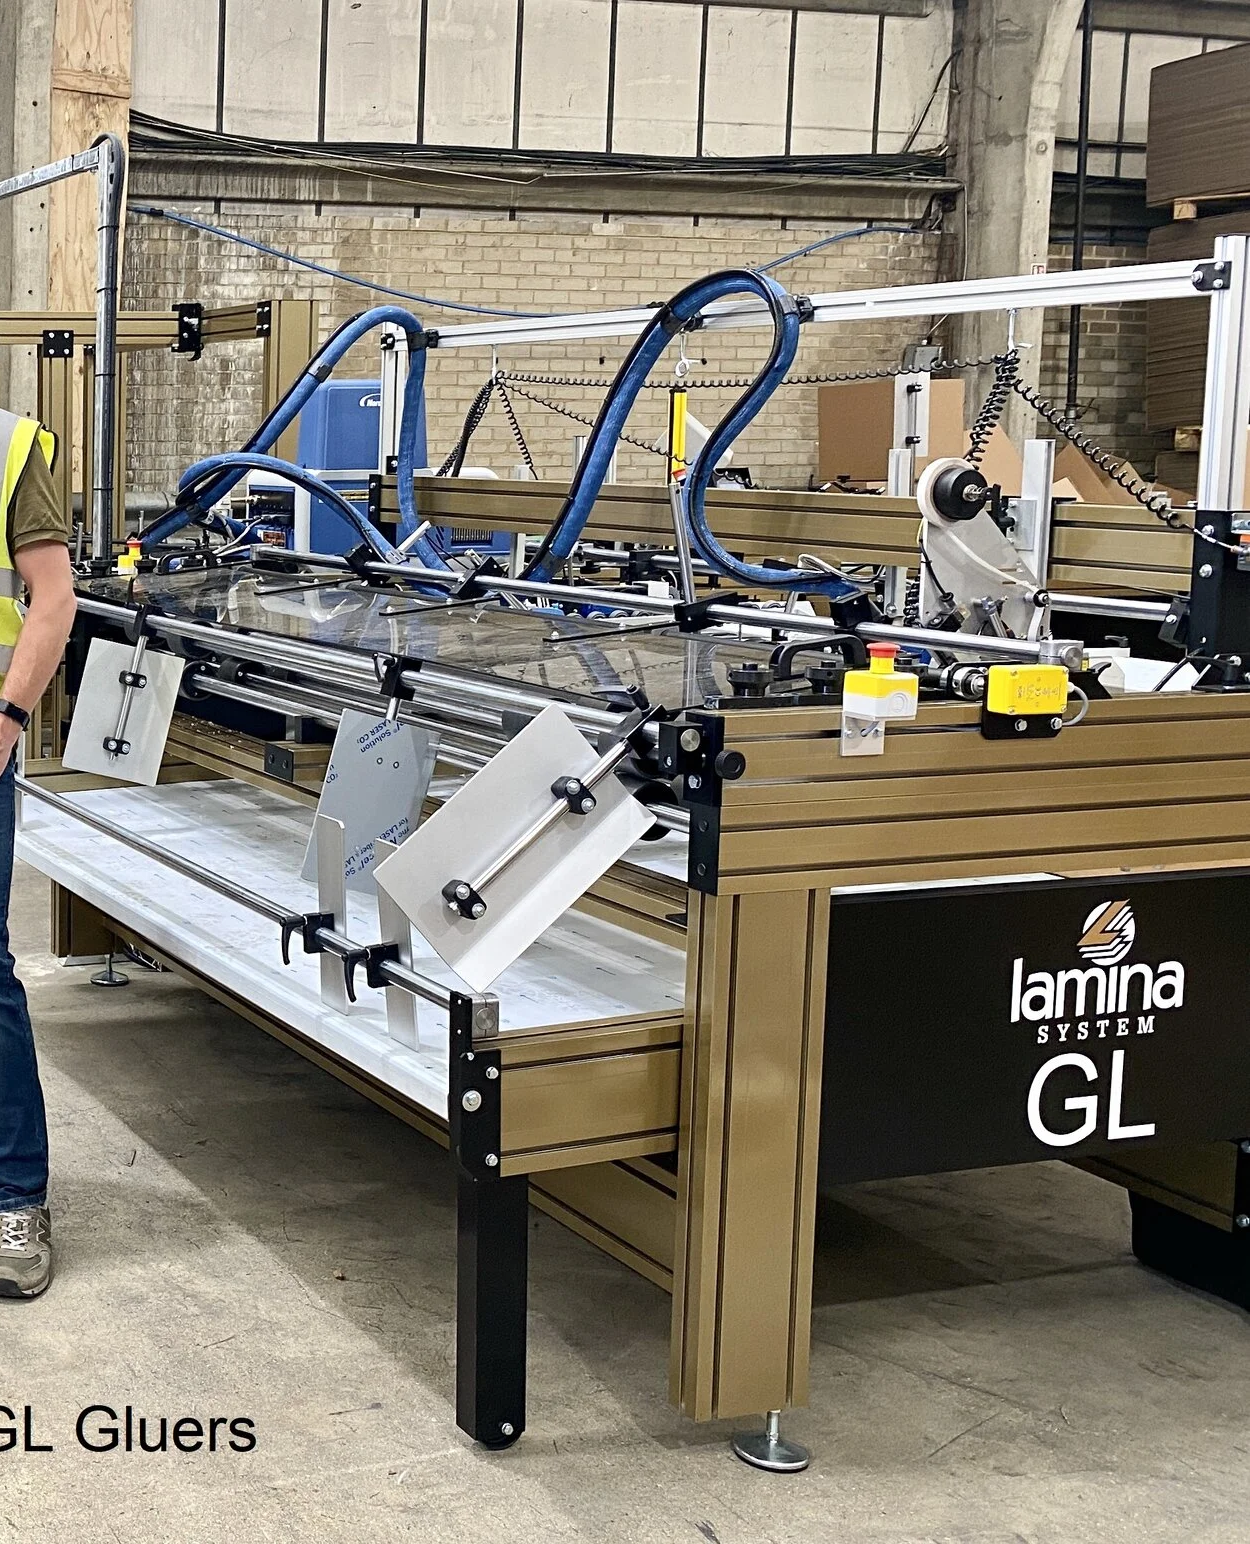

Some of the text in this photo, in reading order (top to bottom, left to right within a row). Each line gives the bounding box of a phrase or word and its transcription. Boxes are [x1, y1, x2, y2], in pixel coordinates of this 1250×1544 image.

[360, 729, 392, 753] Solution
[1010, 957, 1185, 1023] lamina
[1037, 1015, 1155, 1044] SYSTEM
[1026, 1049, 1156, 1148] GL
